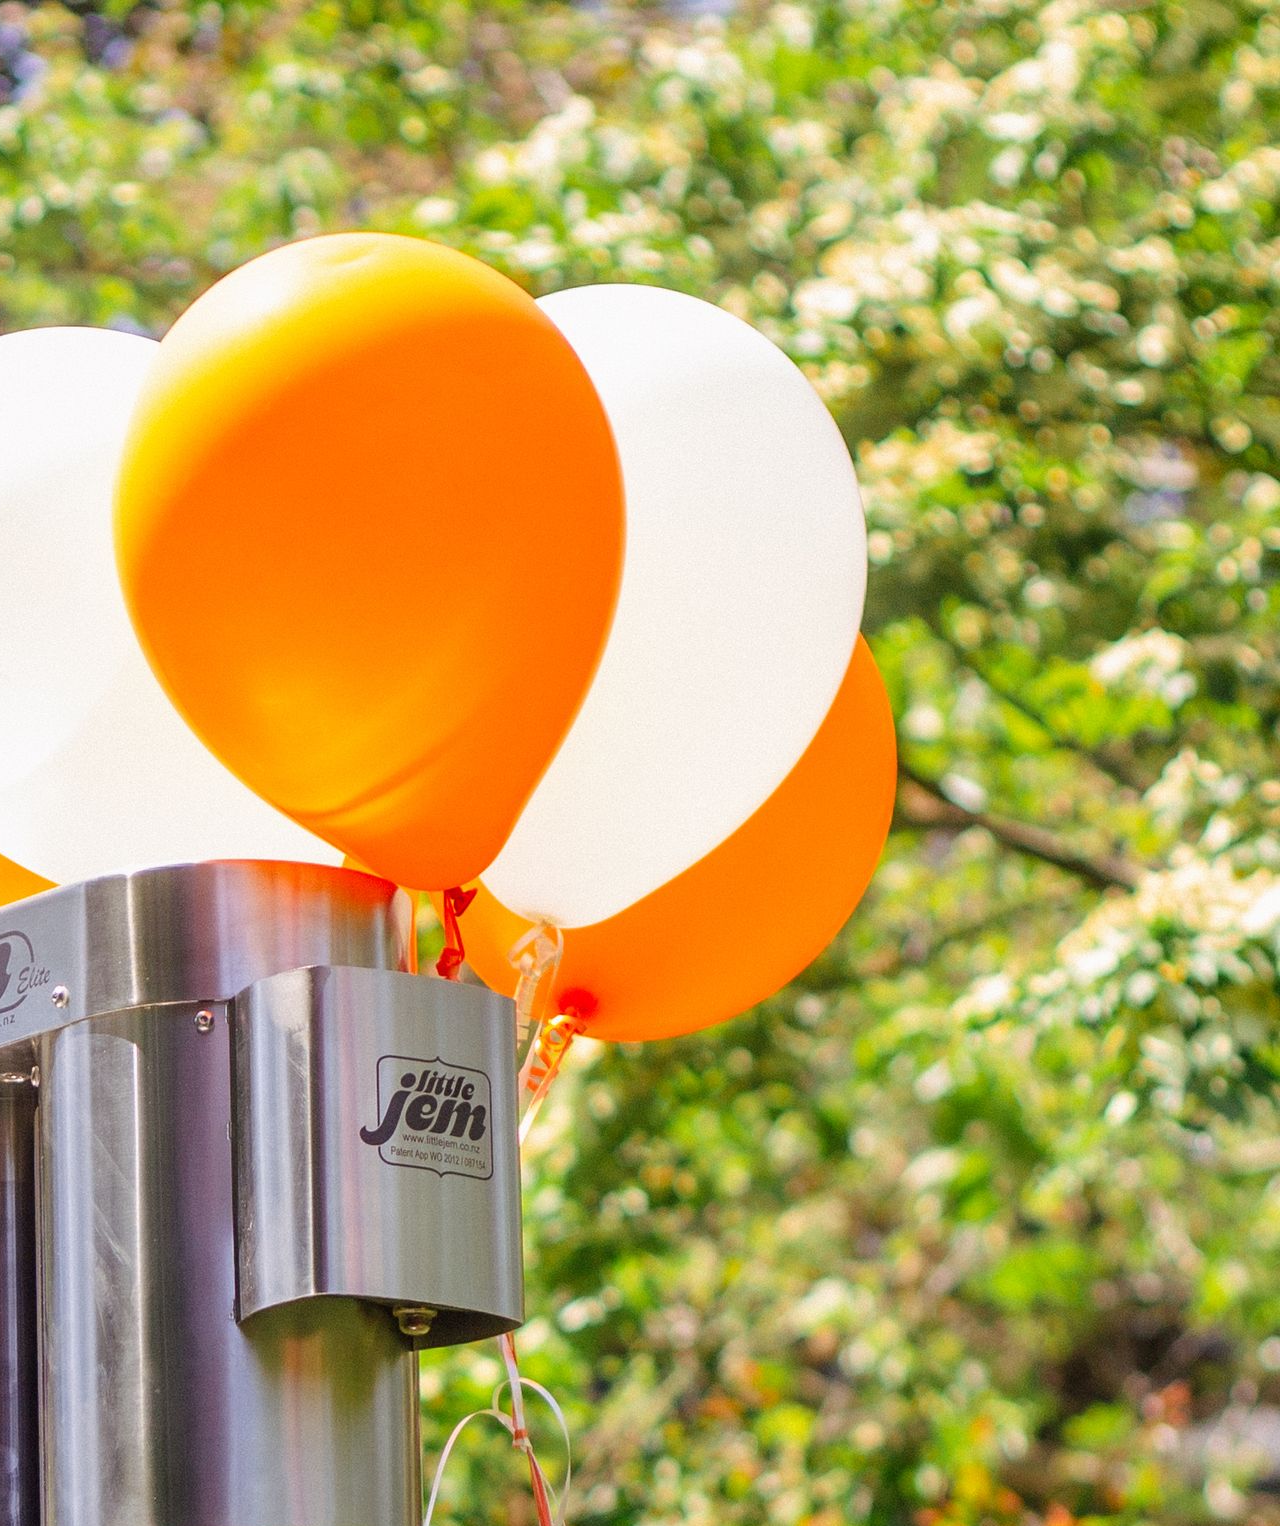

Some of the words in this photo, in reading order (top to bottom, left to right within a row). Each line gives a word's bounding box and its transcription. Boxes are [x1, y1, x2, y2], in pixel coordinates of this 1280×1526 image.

[17, 967, 51, 994] Elite
[416, 1070, 475, 1100] little
[359, 1073, 487, 1146] jem
[390, 1146, 413, 1158] Patent
[415, 1150, 428, 1160] App
[444, 1155, 459, 1165] 2012
